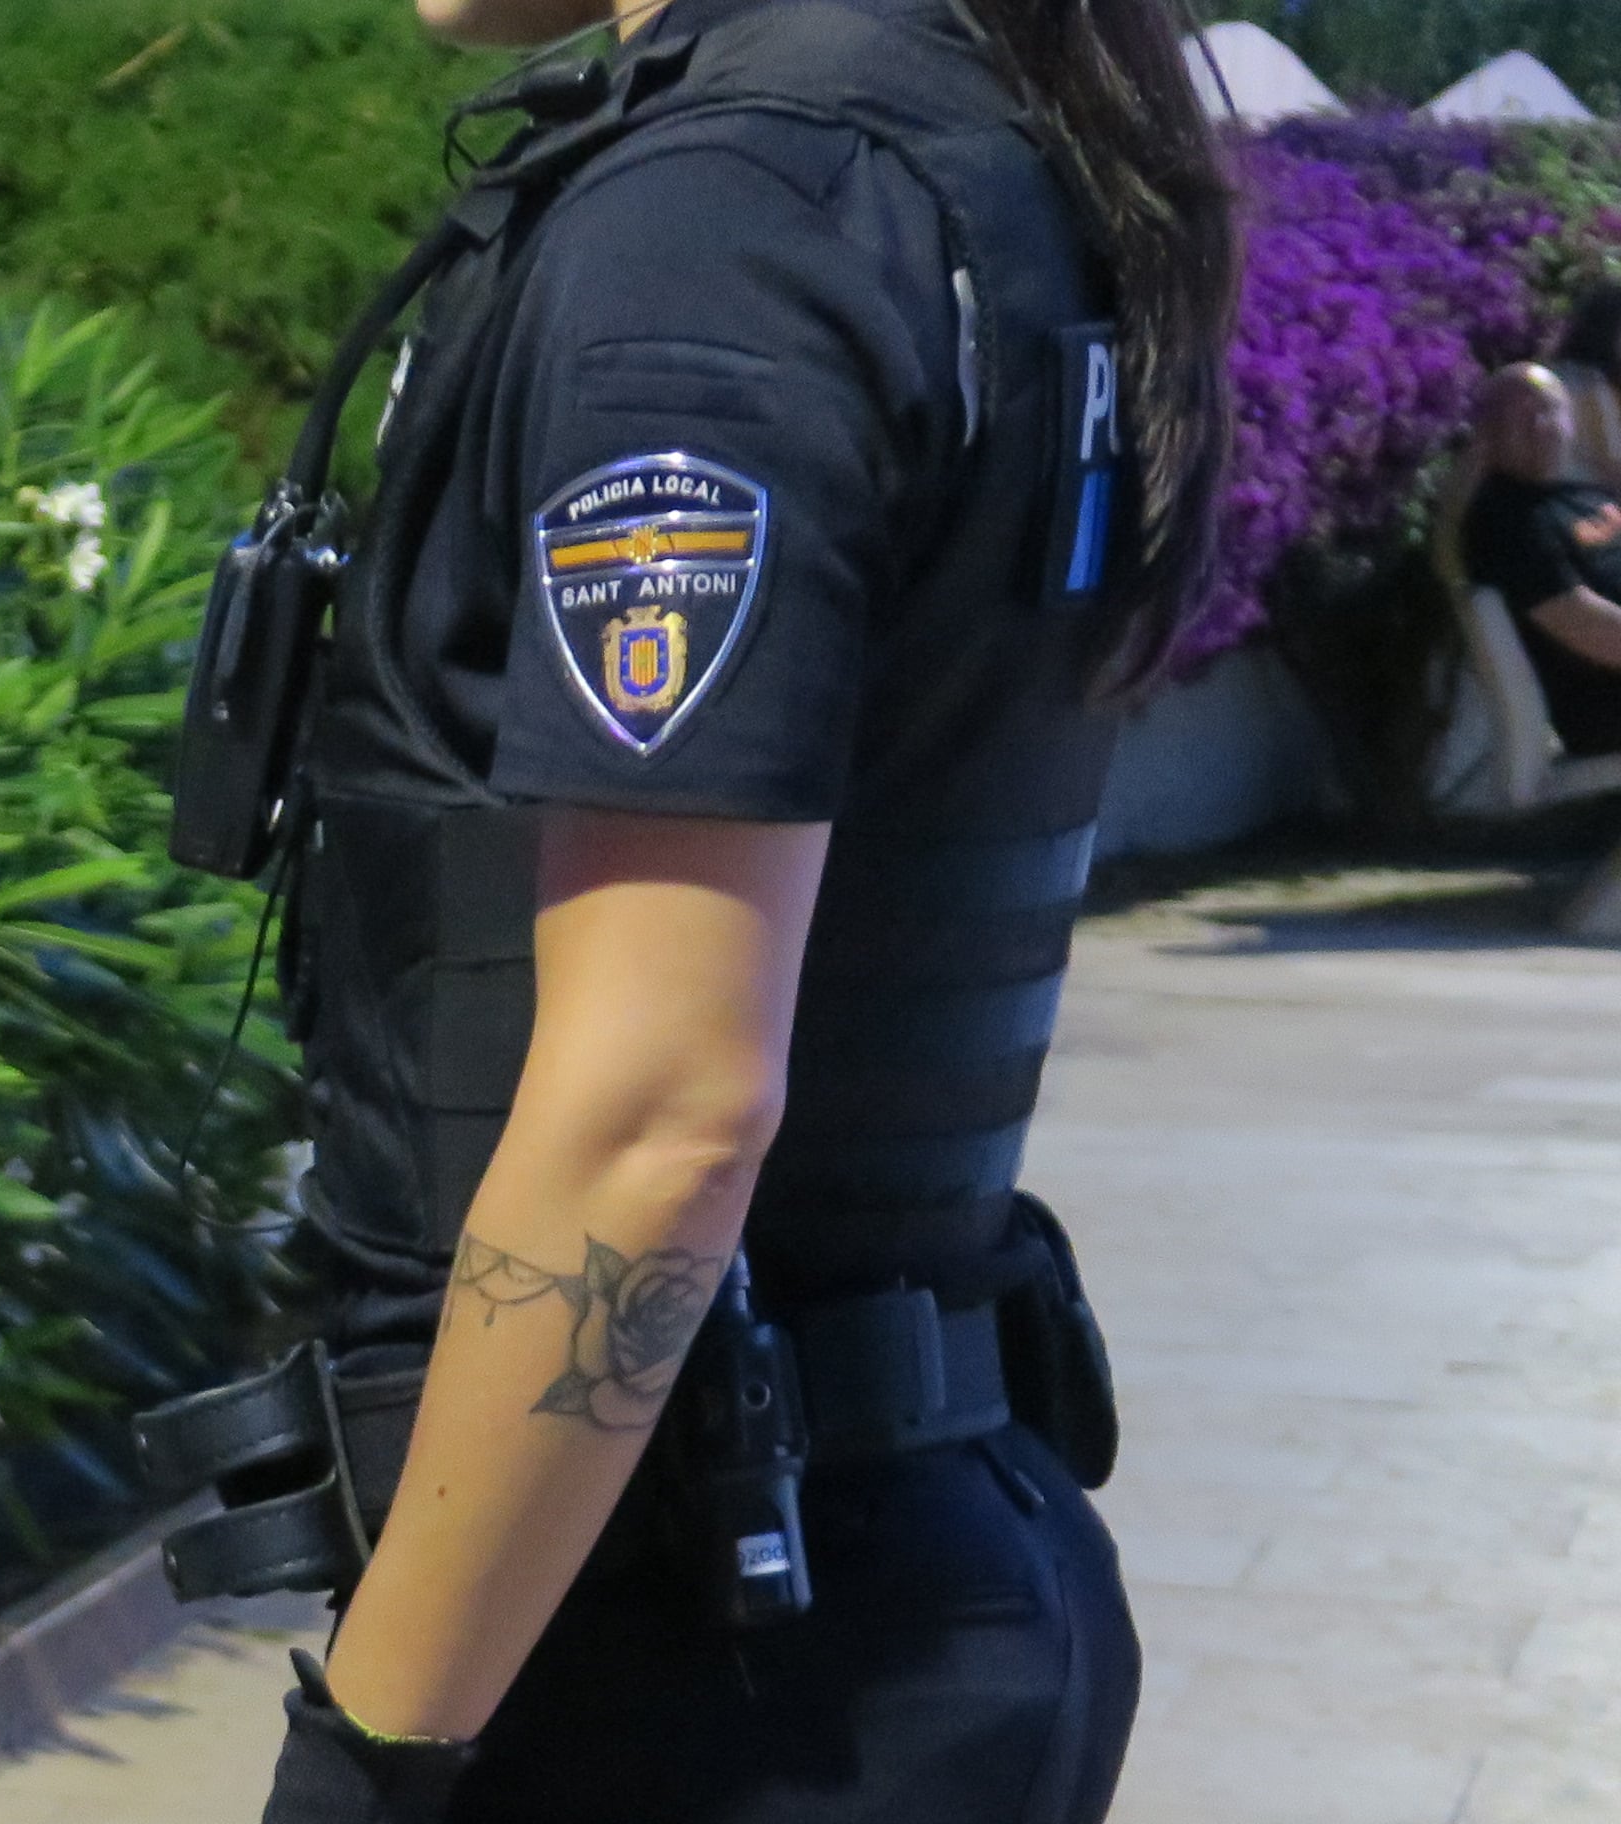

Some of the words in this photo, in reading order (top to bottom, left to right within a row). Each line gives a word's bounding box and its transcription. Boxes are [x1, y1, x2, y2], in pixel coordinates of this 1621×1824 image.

[568, 476, 645, 521] POLICIA
[653, 474, 721, 505] LOCAL
[561, 580, 621, 608] SANT
[639, 573, 737, 599] ANTONI
